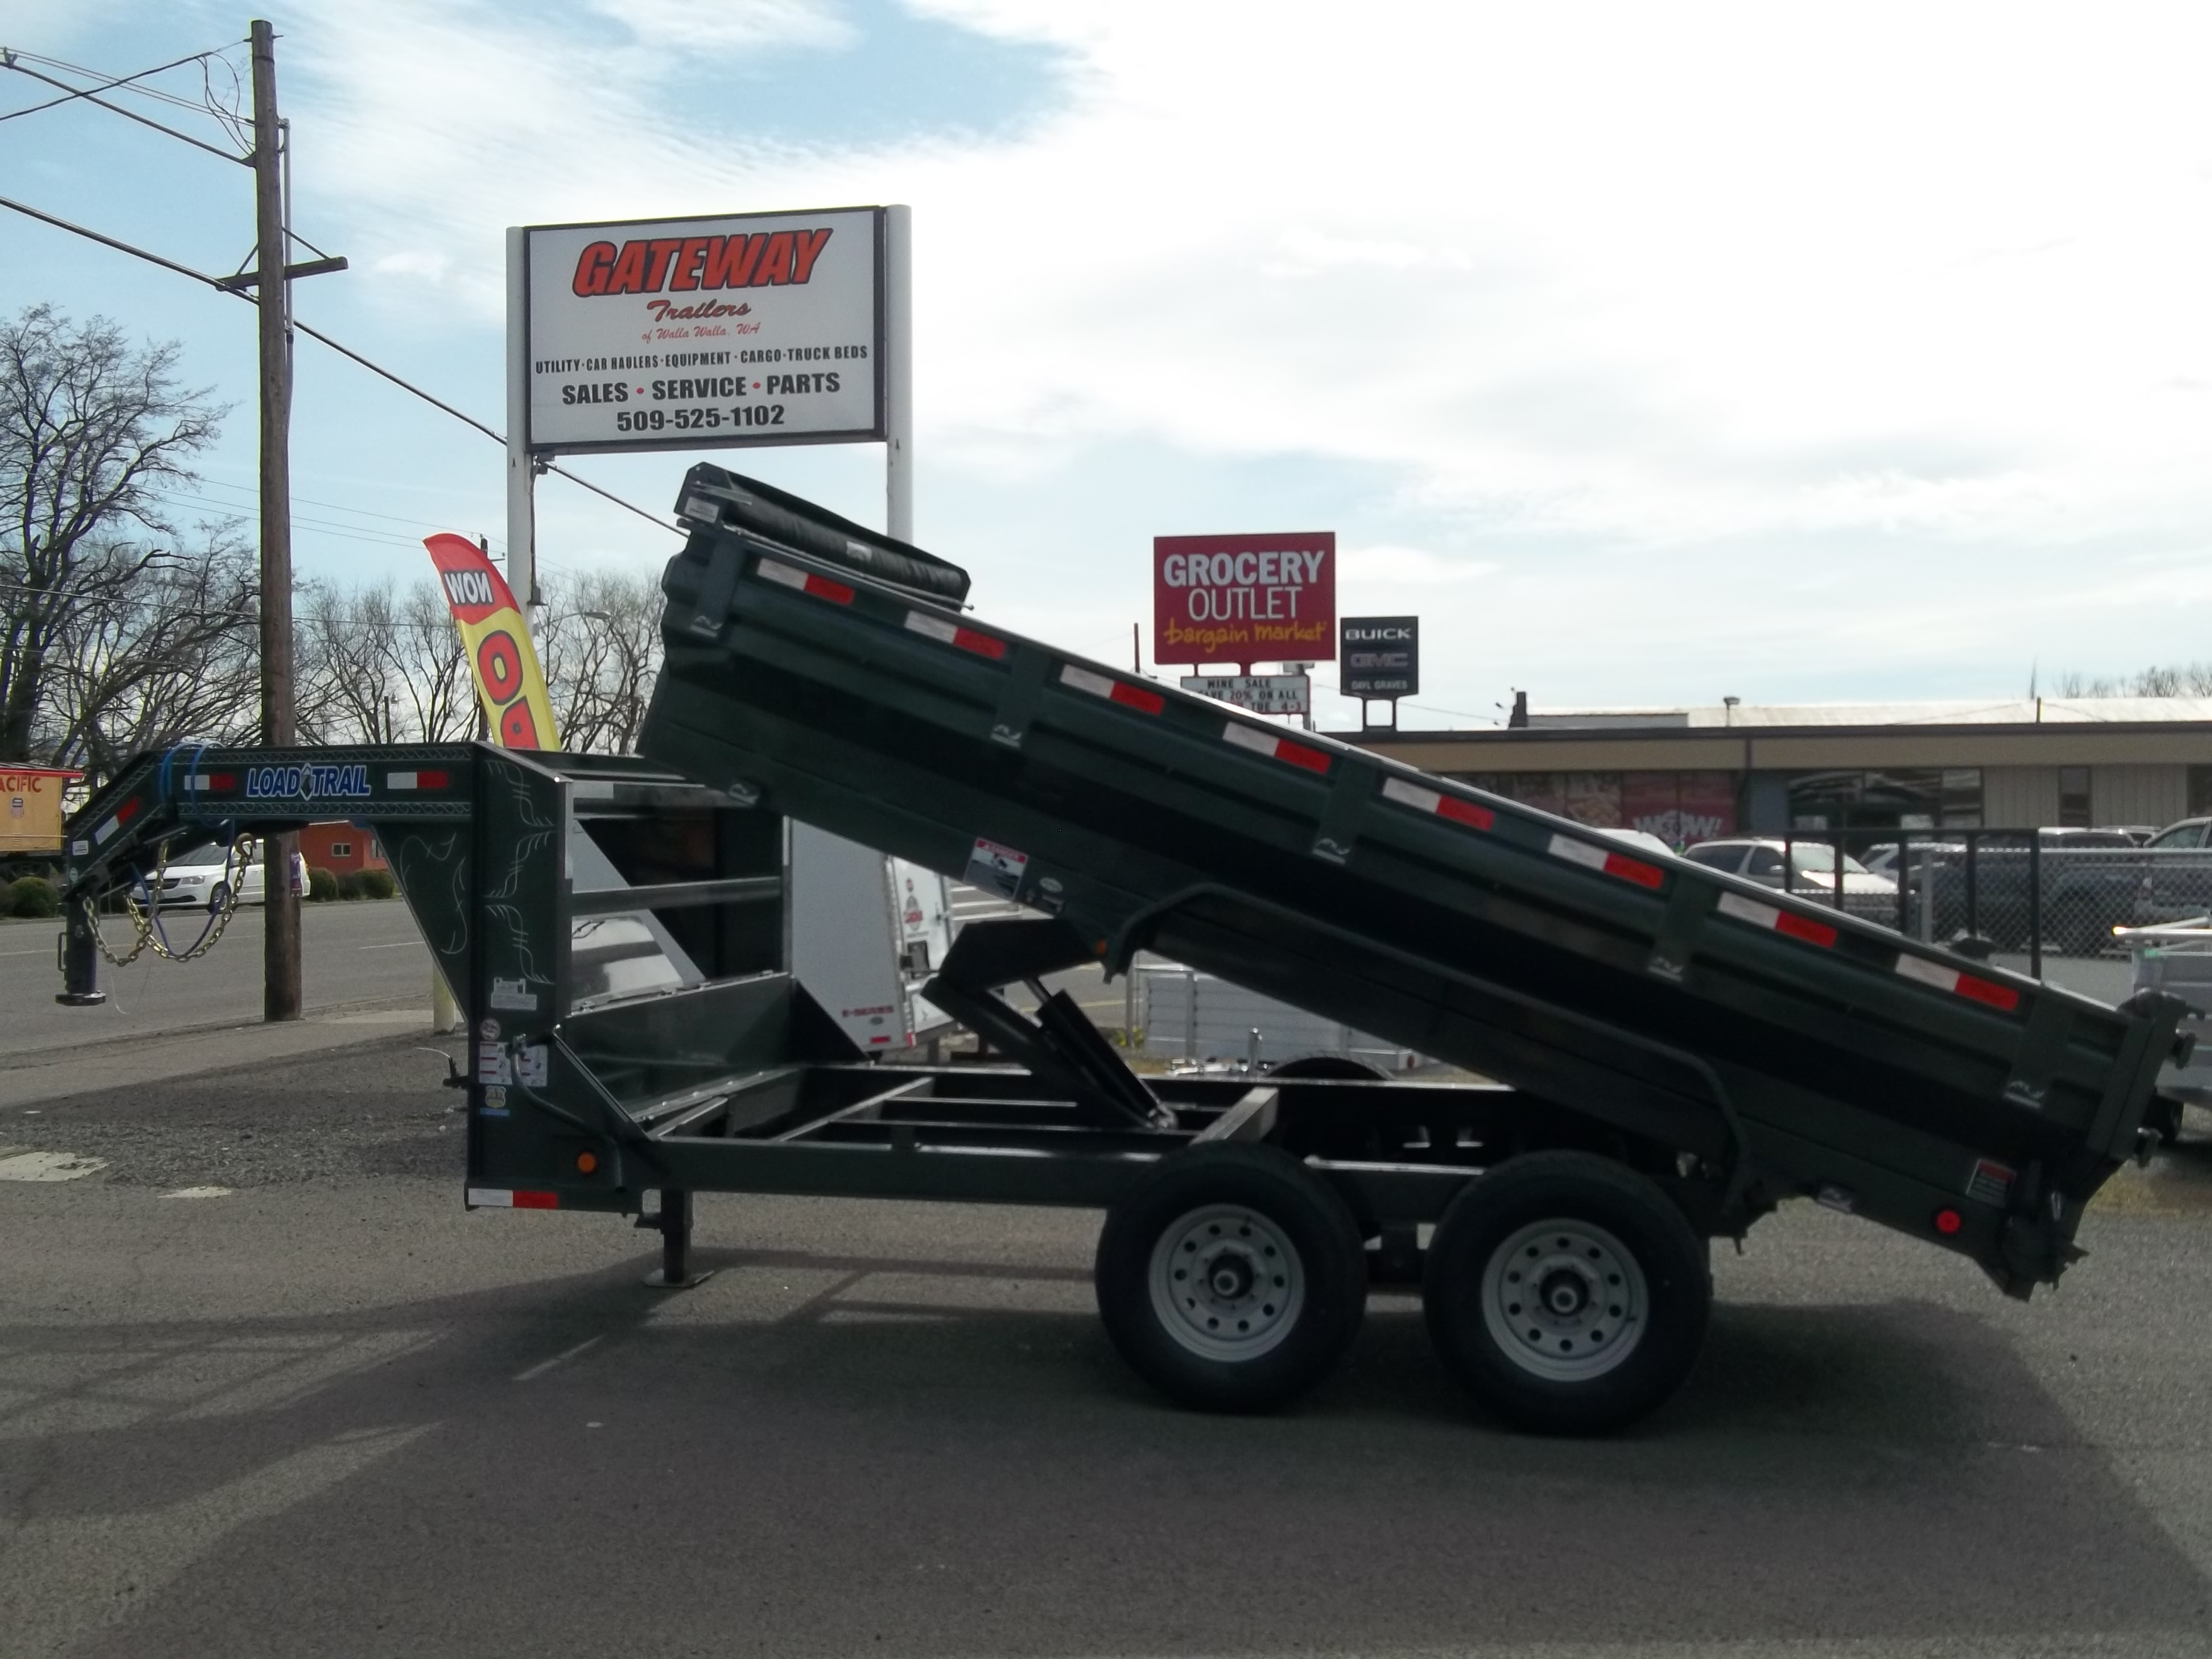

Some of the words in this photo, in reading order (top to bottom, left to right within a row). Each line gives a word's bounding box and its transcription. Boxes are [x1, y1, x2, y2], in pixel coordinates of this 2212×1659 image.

[572, 228, 834, 298] GATEWAY
[647, 298, 751, 322] Trailers
[642, 329, 652, 344] of
[656, 327, 689, 339] Walla
[737, 322, 761, 335] WA
[535, 359, 580, 374] UTILITY
[586, 357, 607, 371] CAR
[611, 354, 658, 370] HAULERS
[665, 351, 730, 368] EQUIPMENT
[740, 349, 781, 364] CARGO
[788, 347, 830, 362] TRUCK
[834, 345, 868, 360] BEDS
[562, 382, 628, 404] SALES
[652, 376, 747, 400] SERVICE
[767, 372, 840, 395] PARTS
[617, 404, 785, 431] 509-525-1102
[1164, 550, 1325, 588] GROCERY
[1188, 586, 1303, 621] OUTLET
[1163, 617, 1249, 654] bargain
[1254, 621, 1327, 643] market
[1345, 628, 1412, 640] BUICK
[1351, 653, 1408, 668] GMC
[1245, 678, 1271, 688] SALE
[1278, 689, 1297, 700] ALL
[247, 767, 301, 798] LOAD
[310, 765, 371, 798] TRAIL
